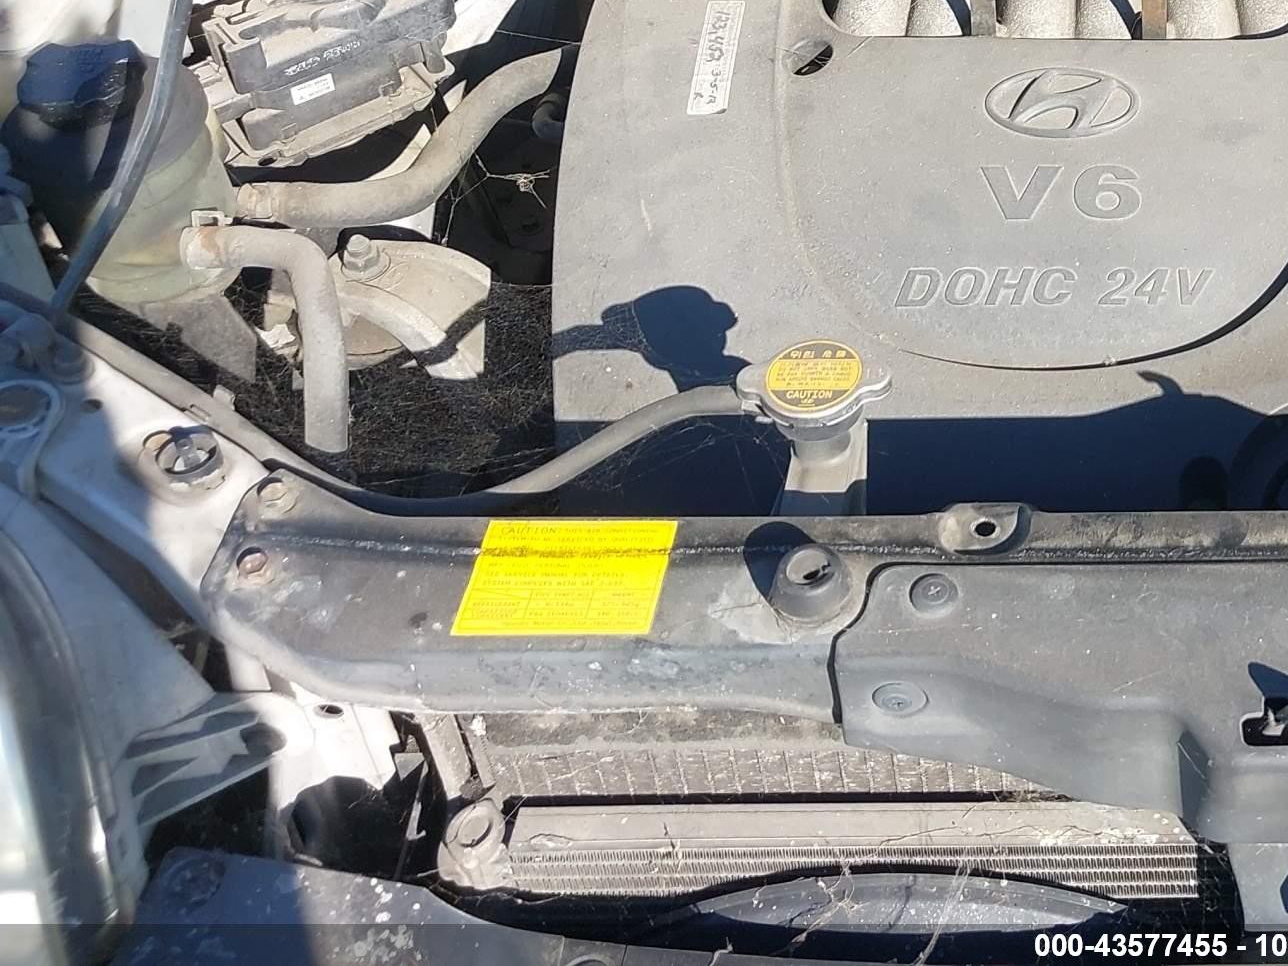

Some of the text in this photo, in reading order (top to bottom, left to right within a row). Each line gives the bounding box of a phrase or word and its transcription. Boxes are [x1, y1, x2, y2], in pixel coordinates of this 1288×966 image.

[980, 164, 1142, 221] V6
[894, 267, 1214, 308] DOHC 24V
[786, 390, 833, 399] CAUTION
